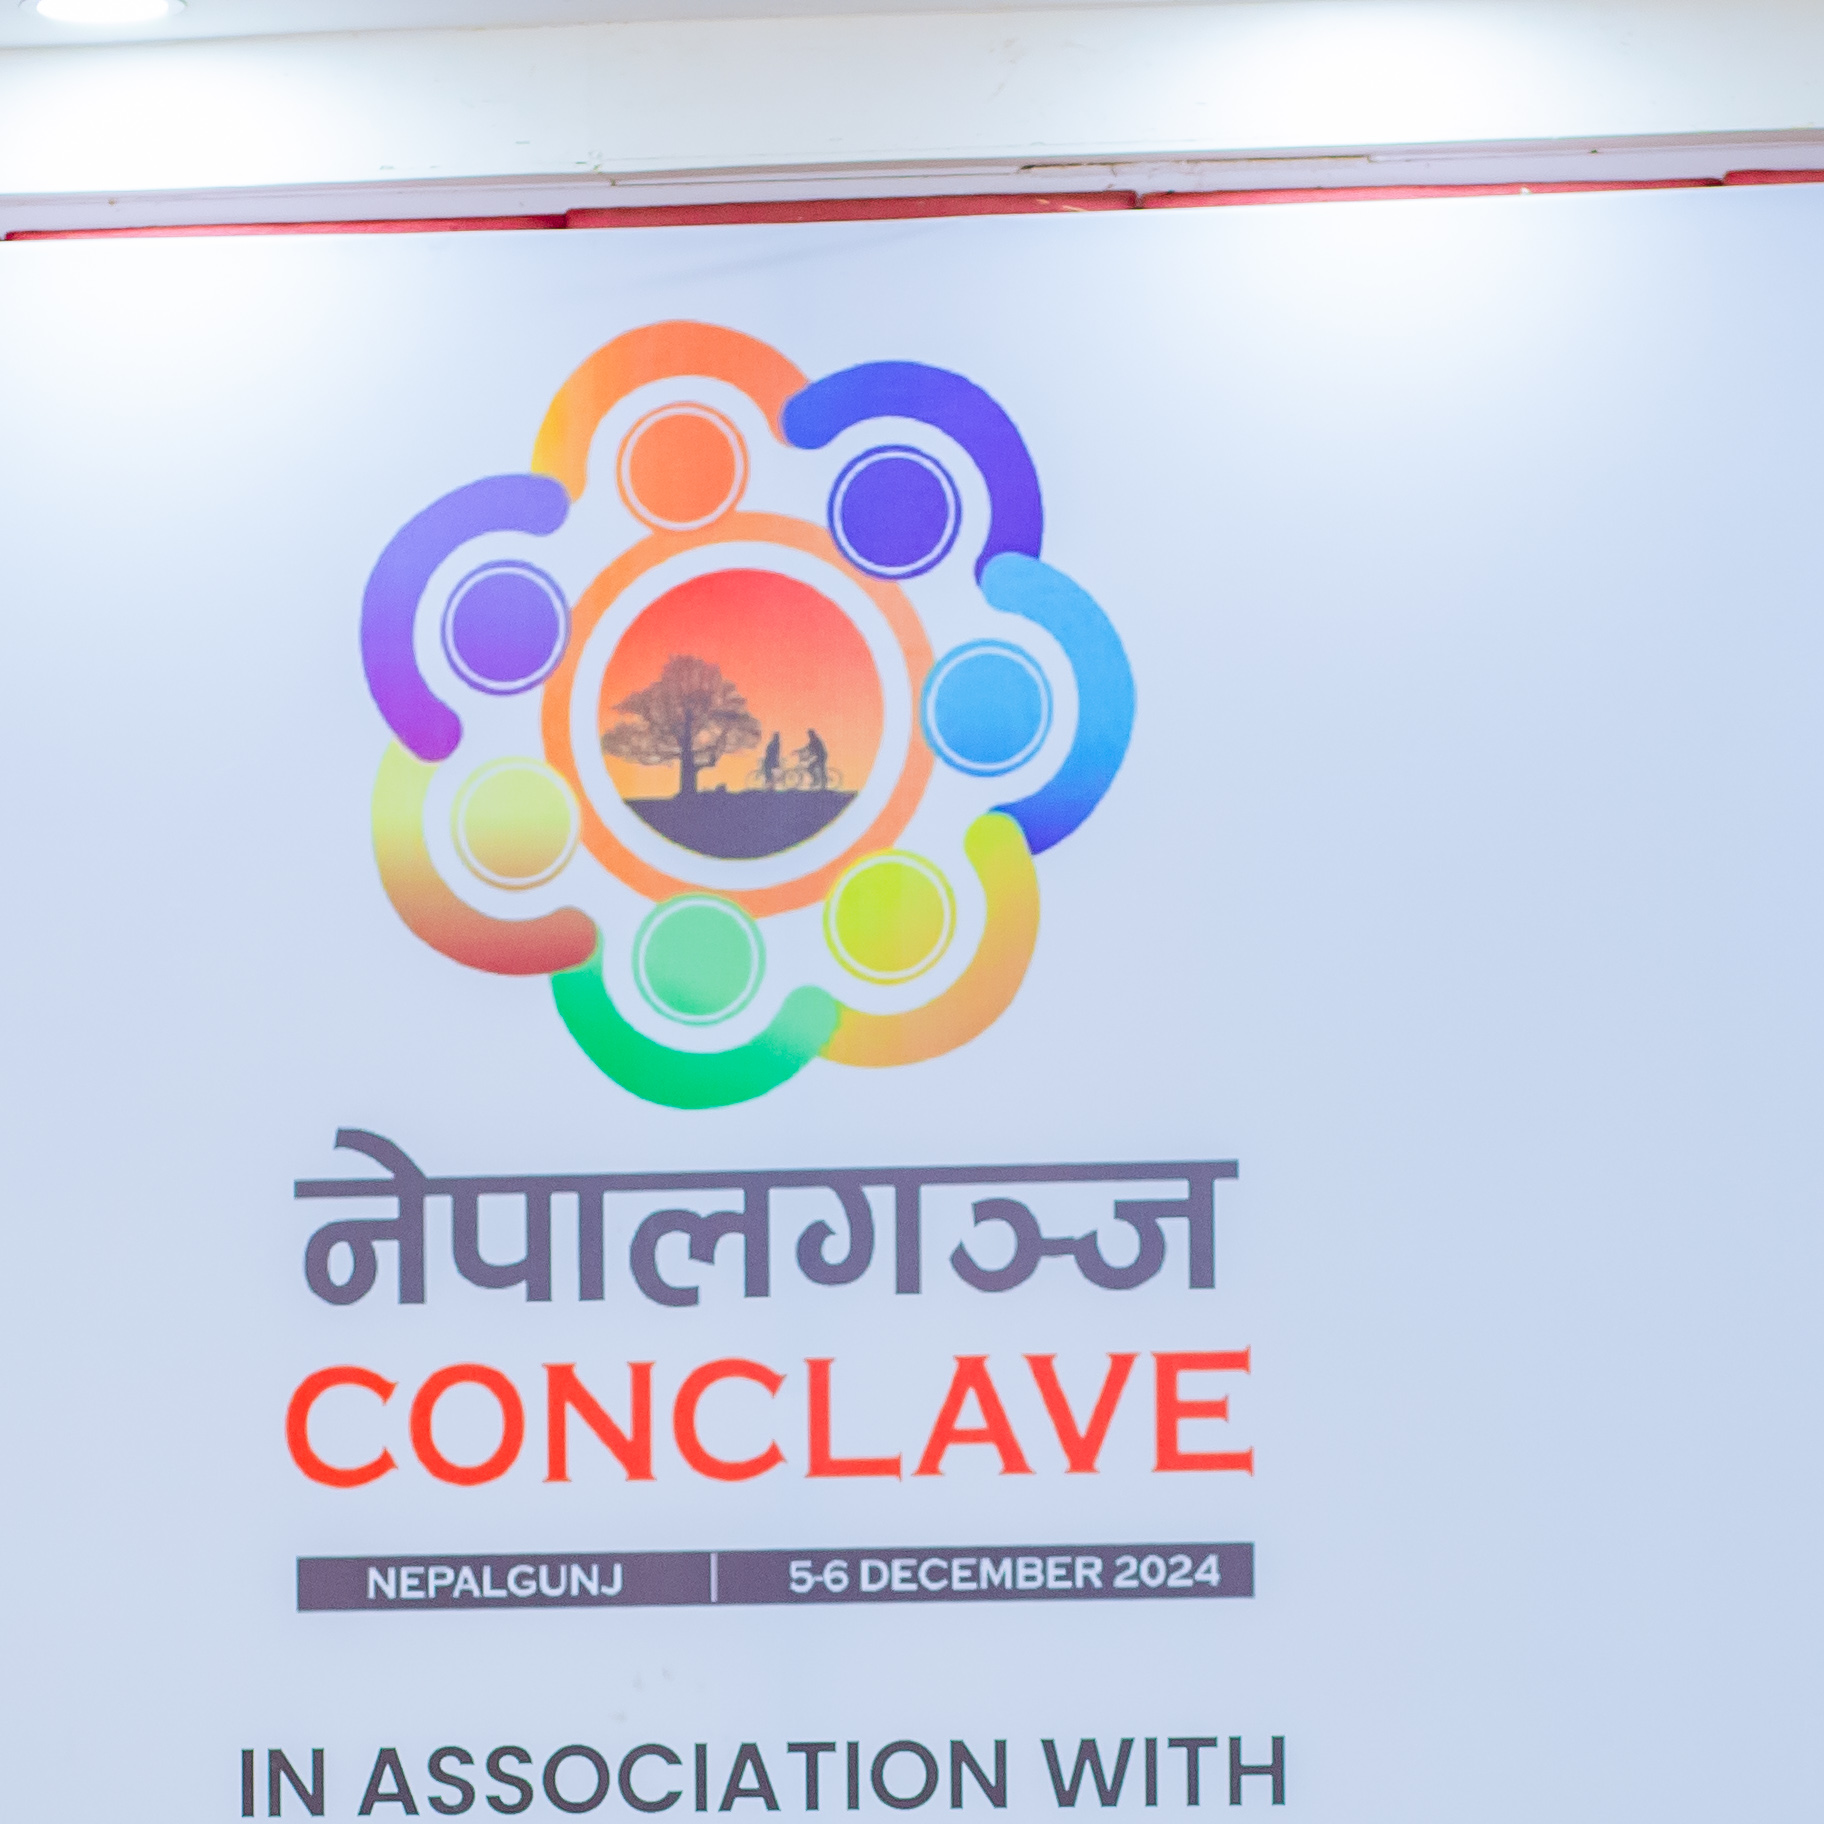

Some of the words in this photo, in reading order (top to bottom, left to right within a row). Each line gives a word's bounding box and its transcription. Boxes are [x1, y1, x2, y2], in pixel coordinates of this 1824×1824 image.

[294, 1127, 1239, 1308] नेपालगञ्ज
[284, 1346, 1255, 1489] CONCLAVE
[366, 1561, 624, 1601] NEPALGUNJ
[788, 1559, 848, 1595] 5-6
[859, 1556, 1104, 1594] DECEMBER
[1113, 1553, 1220, 1590] 2024
[241, 1747, 325, 1818] IN
[356, 1738, 1009, 1817] ASSOCIATION
[1040, 1734, 1287, 1808] WITH
